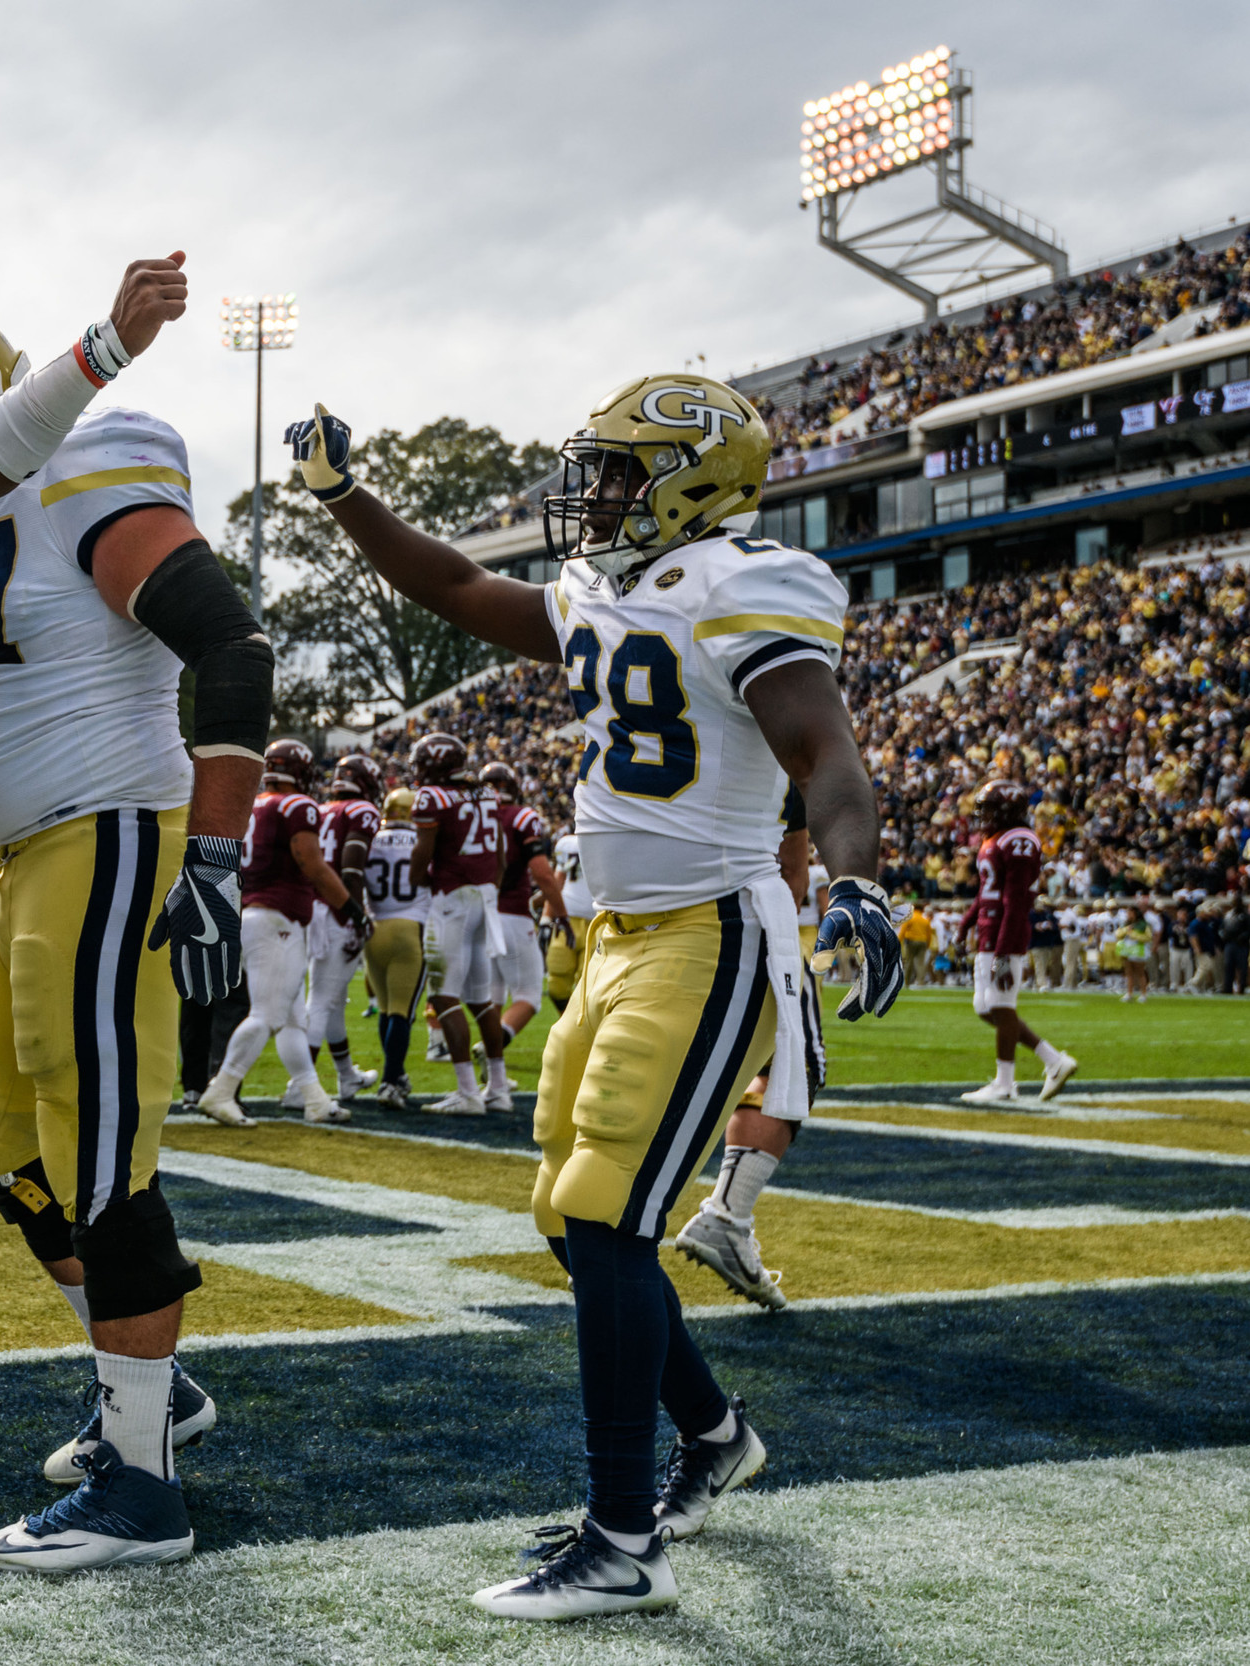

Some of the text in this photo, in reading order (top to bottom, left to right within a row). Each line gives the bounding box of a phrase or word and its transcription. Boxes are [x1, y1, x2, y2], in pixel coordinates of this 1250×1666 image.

[641, 386, 744, 446] GT
[565, 623, 700, 803] 28
[426, 743, 454, 759] VT
[318, 811, 338, 863] 4
[361, 811, 380, 834] 94
[458, 800, 499, 856] 25
[1010, 838, 1034, 857] 22
[364, 857, 418, 902] 30
[976, 858, 1001, 900] 2
